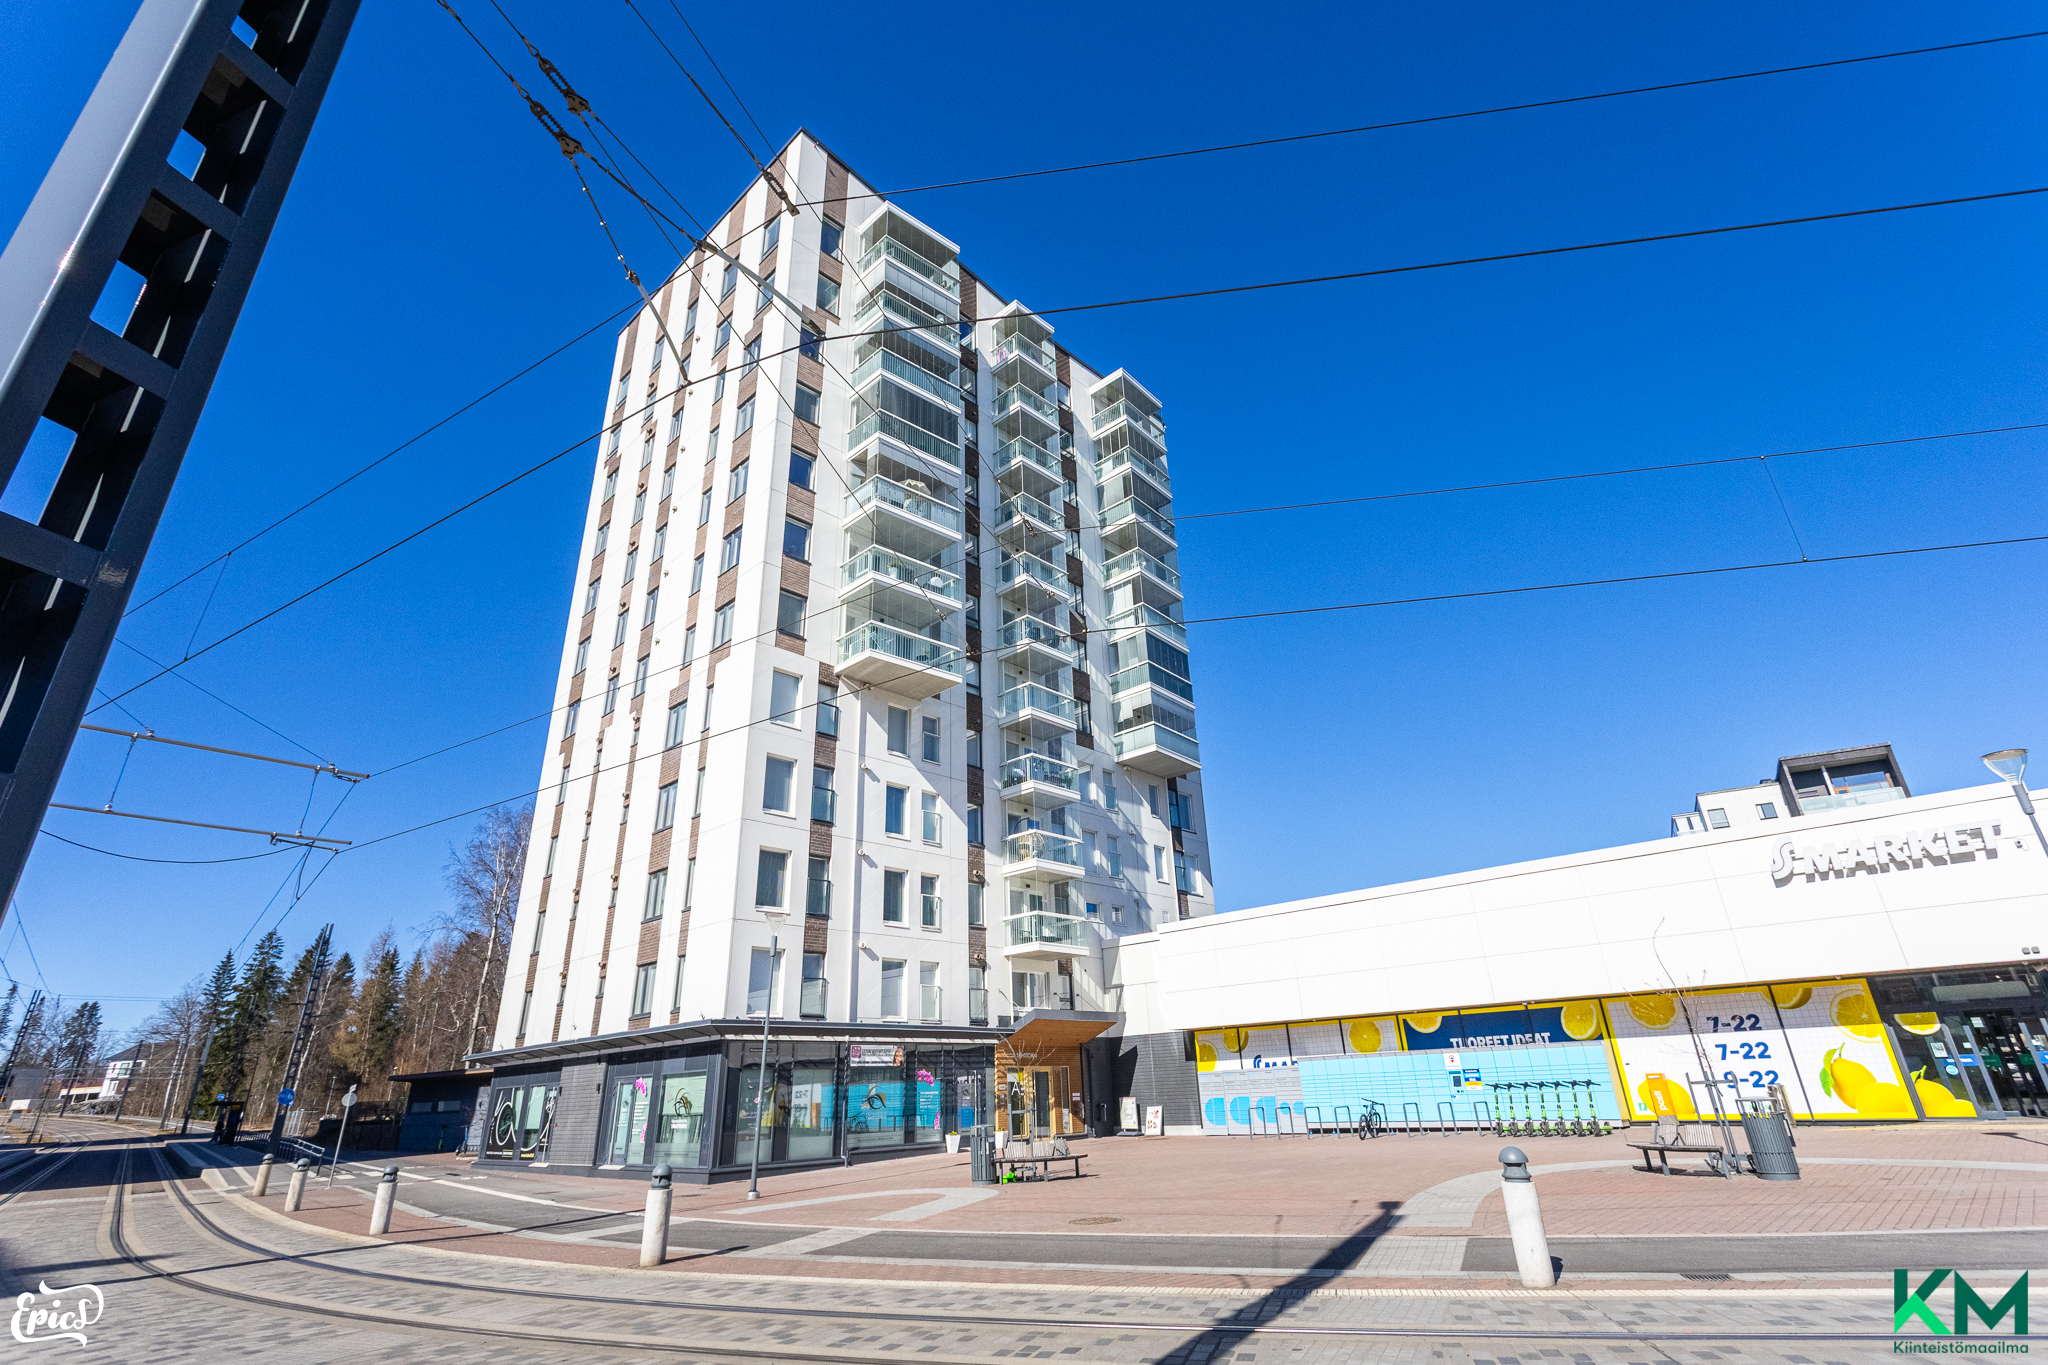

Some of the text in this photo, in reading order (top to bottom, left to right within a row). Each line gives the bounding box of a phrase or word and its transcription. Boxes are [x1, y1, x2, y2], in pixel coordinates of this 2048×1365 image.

[1706, 1014, 1762, 1033] 7-22
[1715, 1042, 1772, 1060] 7-22
[1724, 1070, 1779, 1088] 9-22
[1653, 1090, 1669, 1111] posti
